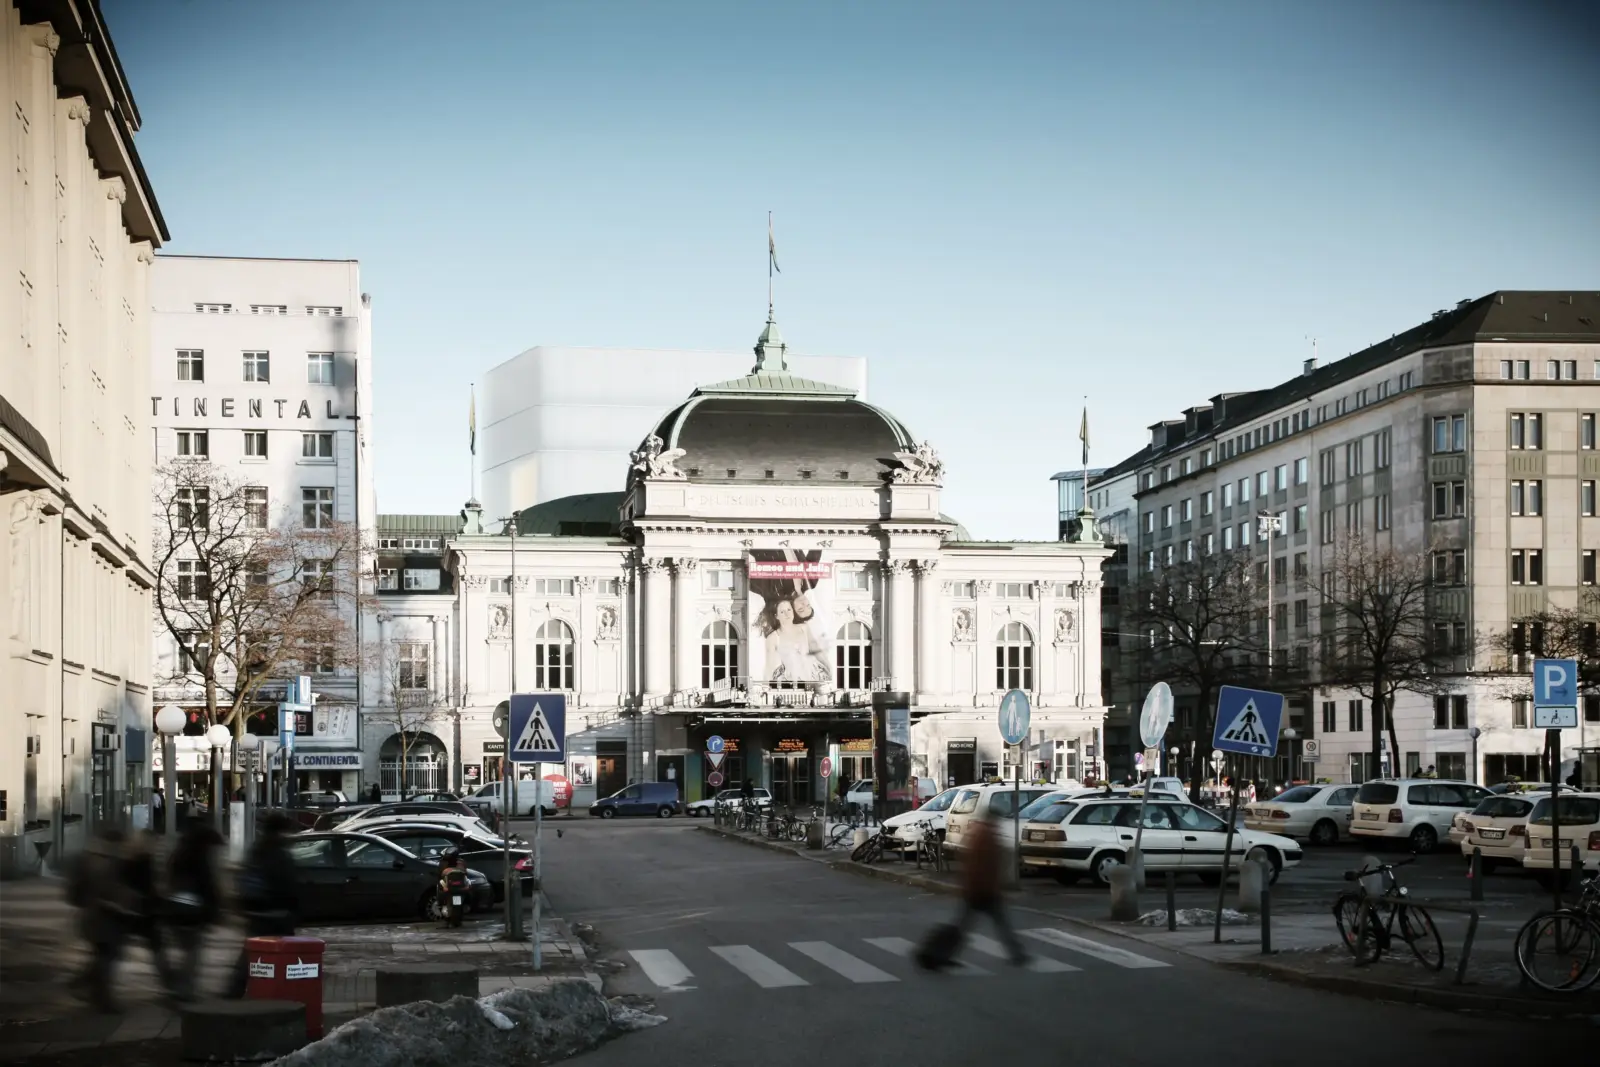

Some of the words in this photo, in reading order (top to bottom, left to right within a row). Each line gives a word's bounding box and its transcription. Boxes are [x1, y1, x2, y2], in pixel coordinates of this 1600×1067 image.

[151, 397, 339, 419] TINENTAL
[750, 562, 784, 572] Romeo
[785, 563, 804, 572] und
[806, 563, 830, 572] Julia
[1544, 665, 1567, 700] P
[274, 756, 301, 766] HEL
[303, 755, 360, 766] CONTINENTAL
